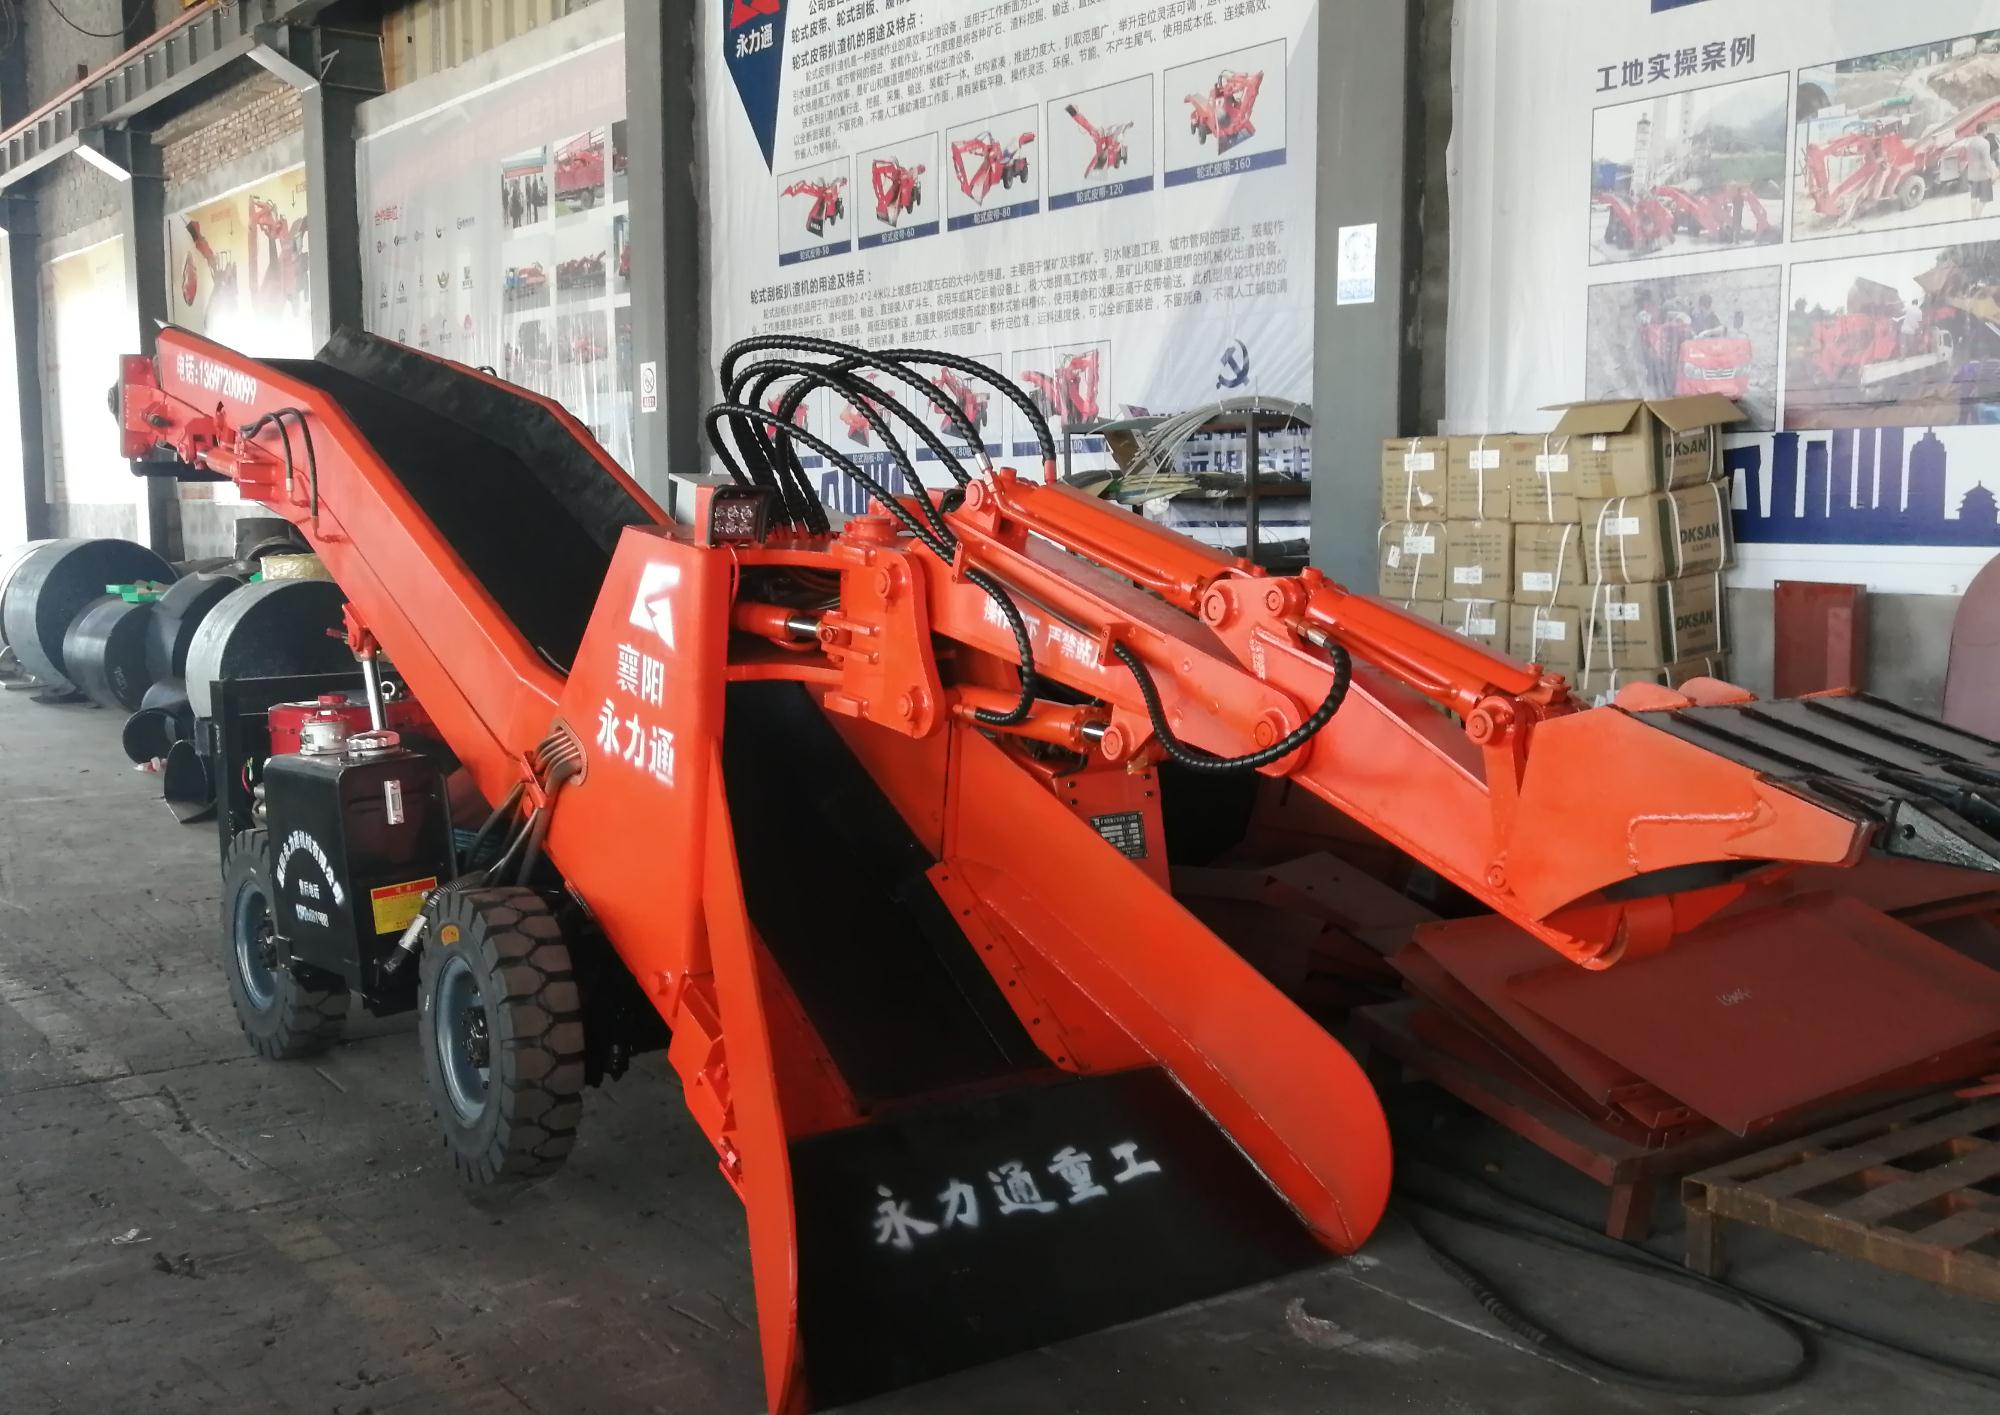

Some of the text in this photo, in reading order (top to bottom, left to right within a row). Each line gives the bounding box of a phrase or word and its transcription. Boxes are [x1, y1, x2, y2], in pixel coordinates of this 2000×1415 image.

[736, 23, 773, 58] 永力通
[1595, 33, 1756, 93] 工地实操案例
[616, 643, 664, 708] 襄阳
[596, 698, 675, 788] 永力通
[872, 1141, 1162, 1249] 永力通重工
